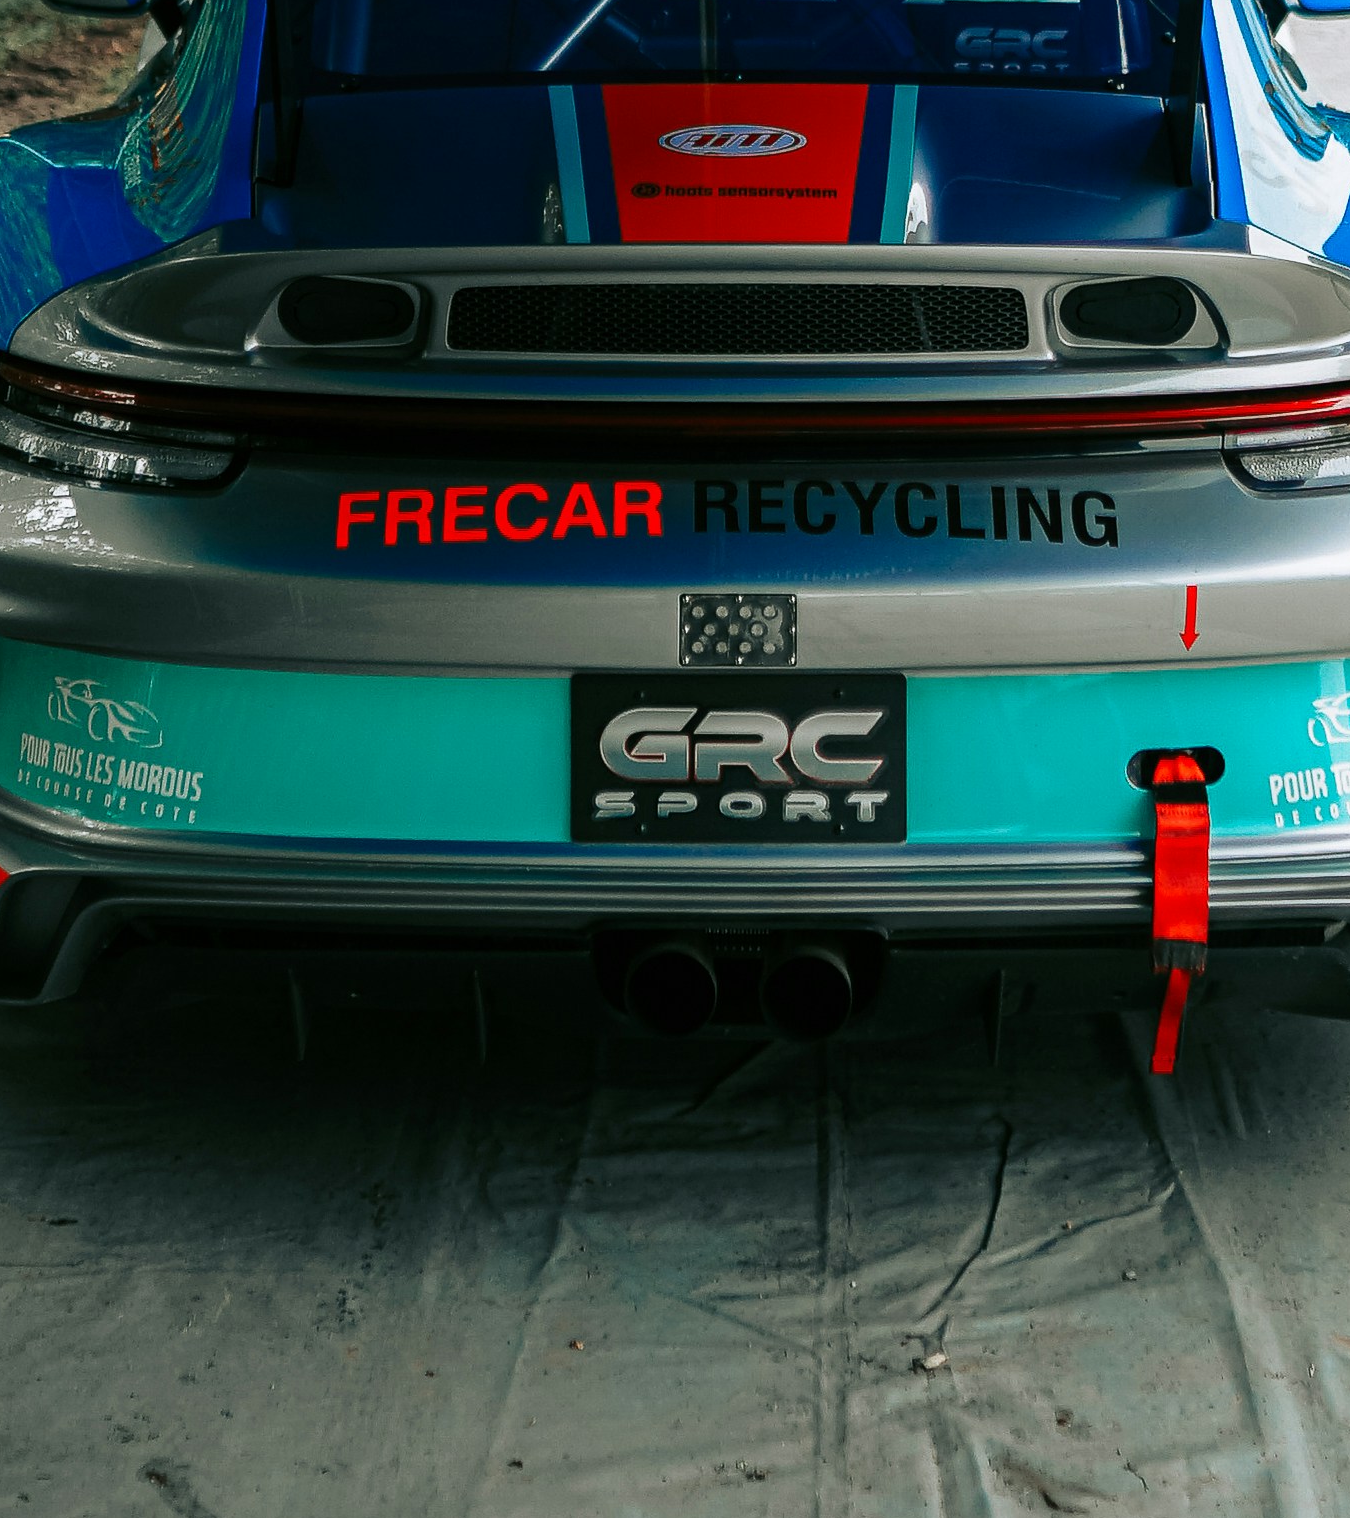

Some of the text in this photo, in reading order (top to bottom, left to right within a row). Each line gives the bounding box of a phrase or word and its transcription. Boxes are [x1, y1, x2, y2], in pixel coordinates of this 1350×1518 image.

[335, 478, 1120, 551] FRECAR RECYCLING
[20, 732, 204, 802] POUR TOUS LES MORDUS
[599, 707, 884, 783] GRC
[593, 791, 890, 822] SPORT
[1269, 767, 1328, 807] POUR
